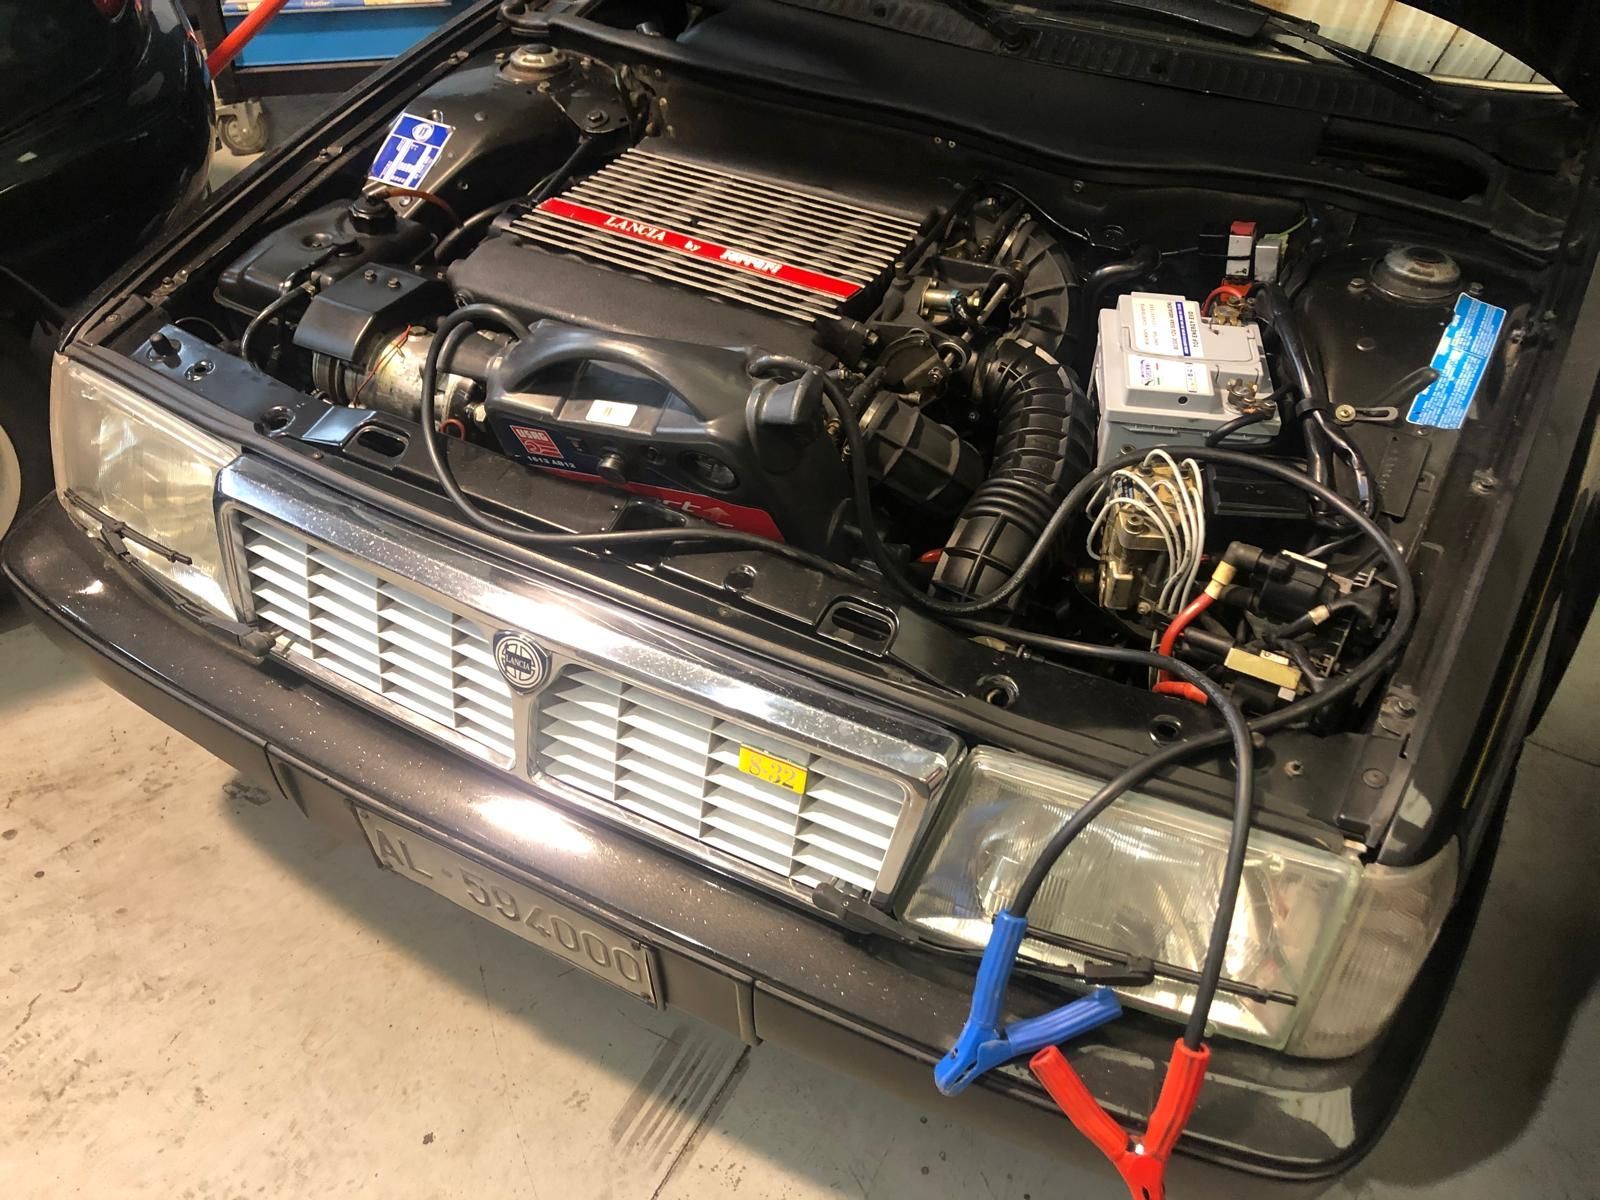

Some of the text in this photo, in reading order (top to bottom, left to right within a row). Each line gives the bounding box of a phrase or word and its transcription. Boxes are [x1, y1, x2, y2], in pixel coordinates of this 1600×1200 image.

[604, 216, 667, 242] LANCIA
[684, 240, 701, 252] by
[515, 428, 550, 442] USAG
[505, 654, 531, 671] LANCIA
